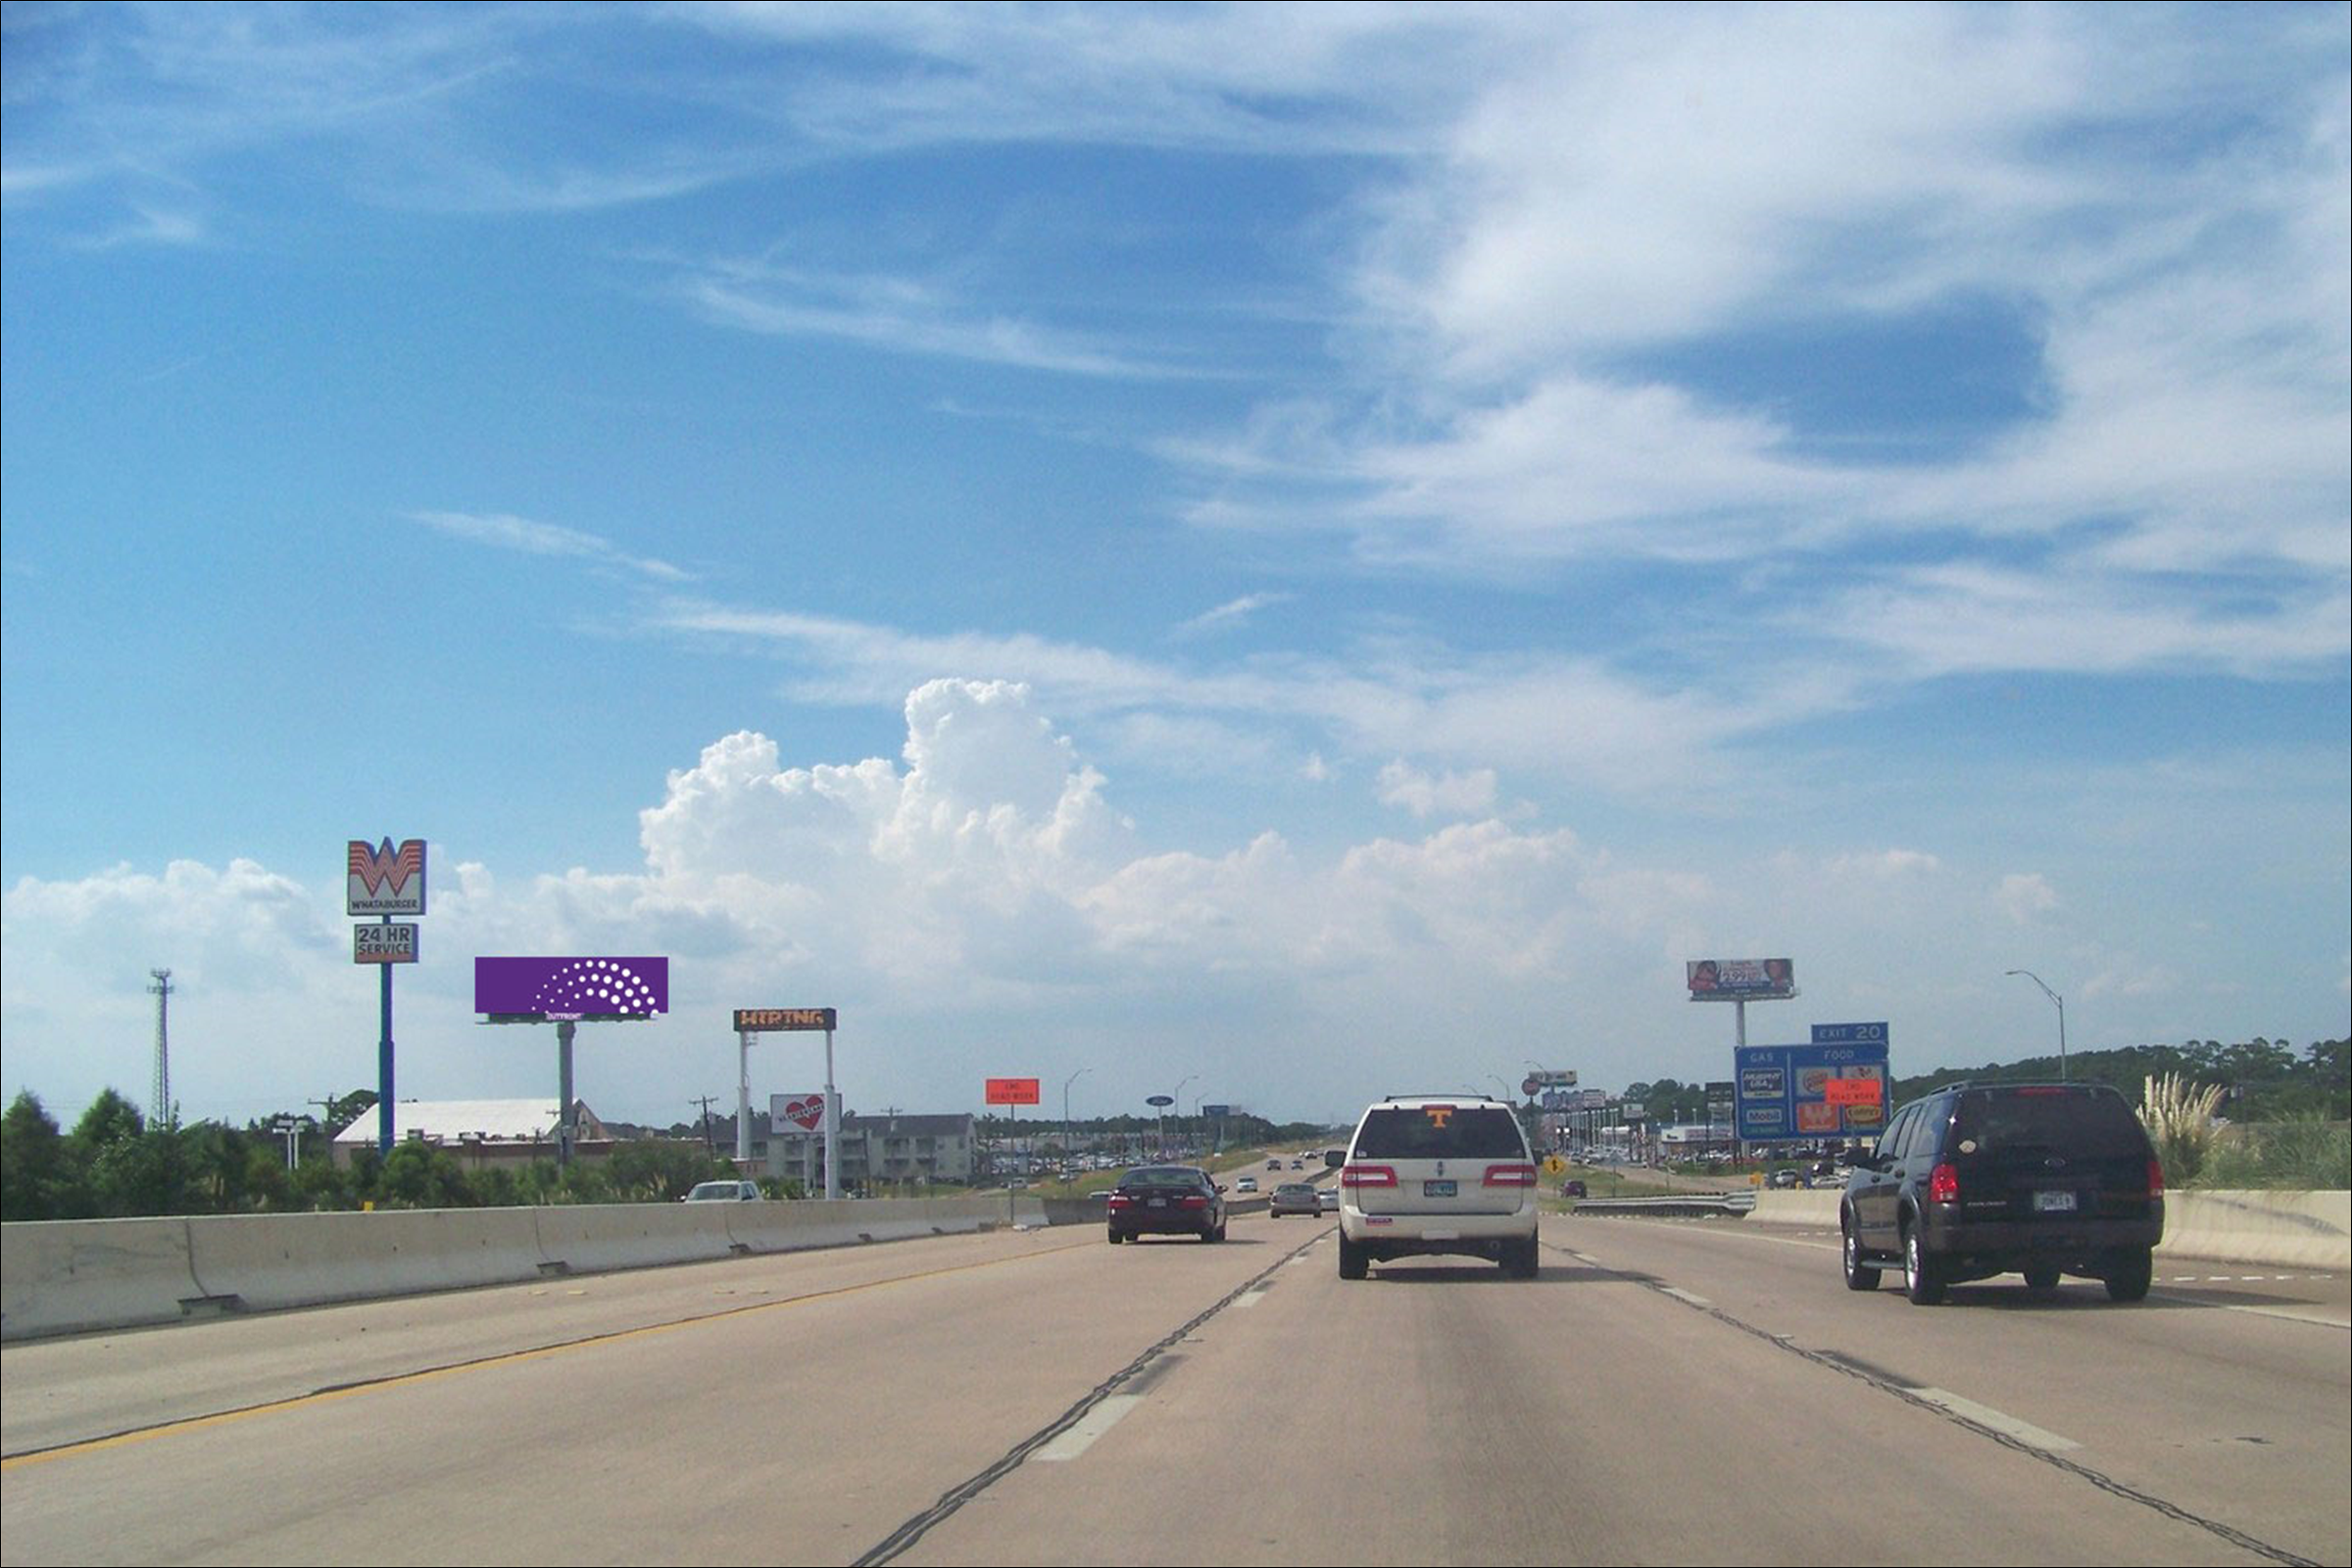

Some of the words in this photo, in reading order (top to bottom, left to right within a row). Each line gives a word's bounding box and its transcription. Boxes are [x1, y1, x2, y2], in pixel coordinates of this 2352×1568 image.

[352, 899, 417, 909] WHATABURGER
[358, 927, 381, 943] 24
[387, 927, 411, 943] HR
[358, 943, 411, 955] SERVICE
[1819, 1028, 1846, 1039] EXIT
[1856, 1025, 1881, 1039] 20
[1750, 1053, 1774, 1063] GAS
[1824, 1050, 1854, 1060] FOOD
[1427, 1109, 1452, 1128] T
[1748, 1108, 1781, 1121] Mobil
